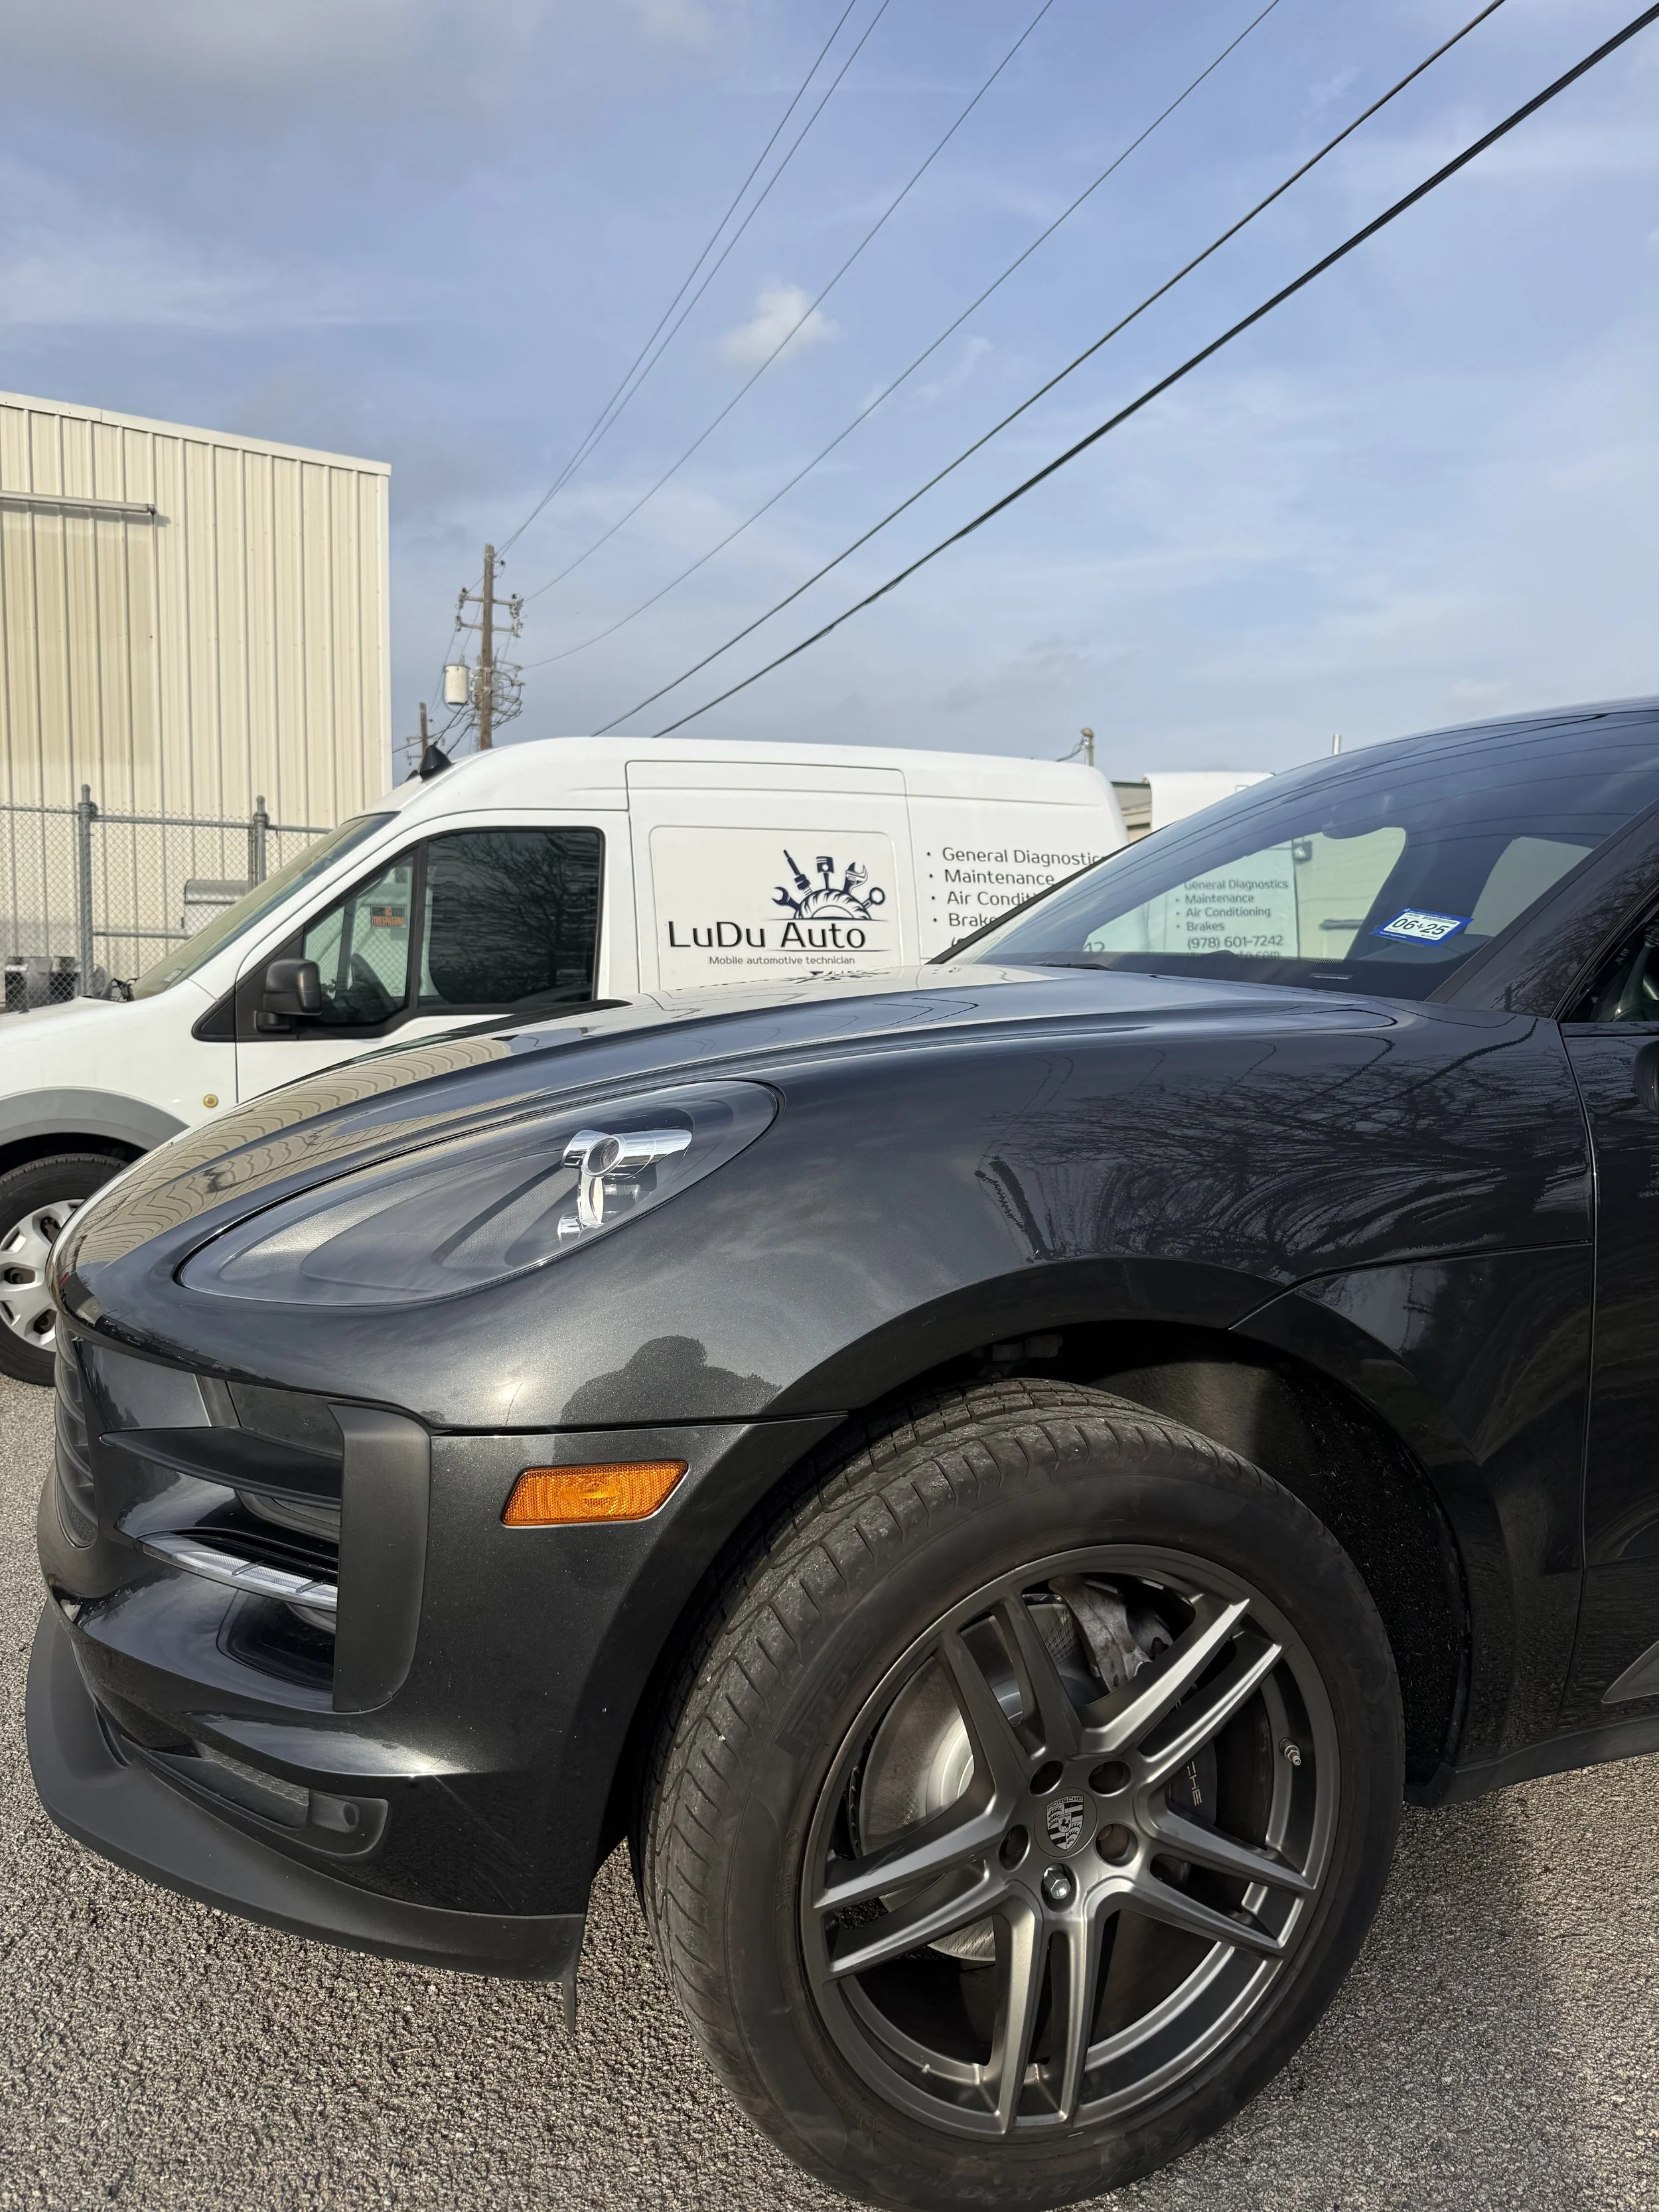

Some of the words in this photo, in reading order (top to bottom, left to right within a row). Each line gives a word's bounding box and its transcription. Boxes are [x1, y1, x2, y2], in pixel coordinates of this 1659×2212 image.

[942, 848, 1007, 863] General
[1014, 850, 1103, 867] Diagnostic
[945, 869, 1054, 885] Maintenance
[1184, 879, 1225, 891] General
[1228, 879, 1289, 891] Diagnostics
[947, 891, 972, 905] Air
[1185, 893, 1254, 904] Maintenance
[1186, 907, 1202, 918] Air
[1204, 906, 1271, 919] Conditioning
[1187, 921, 1226, 932] Brakes
[668, 921, 766, 948] LuDu
[780, 922, 866, 948] Auto
[1187, 936, 1220, 950] (978)
[1224, 934, 1284, 948] 601-7242
[709, 956, 743, 964] Mobile
[747, 956, 803, 964] automotive
[806, 956, 855, 965] technician
[1047, 1796, 1082, 1810] PORSCHE
